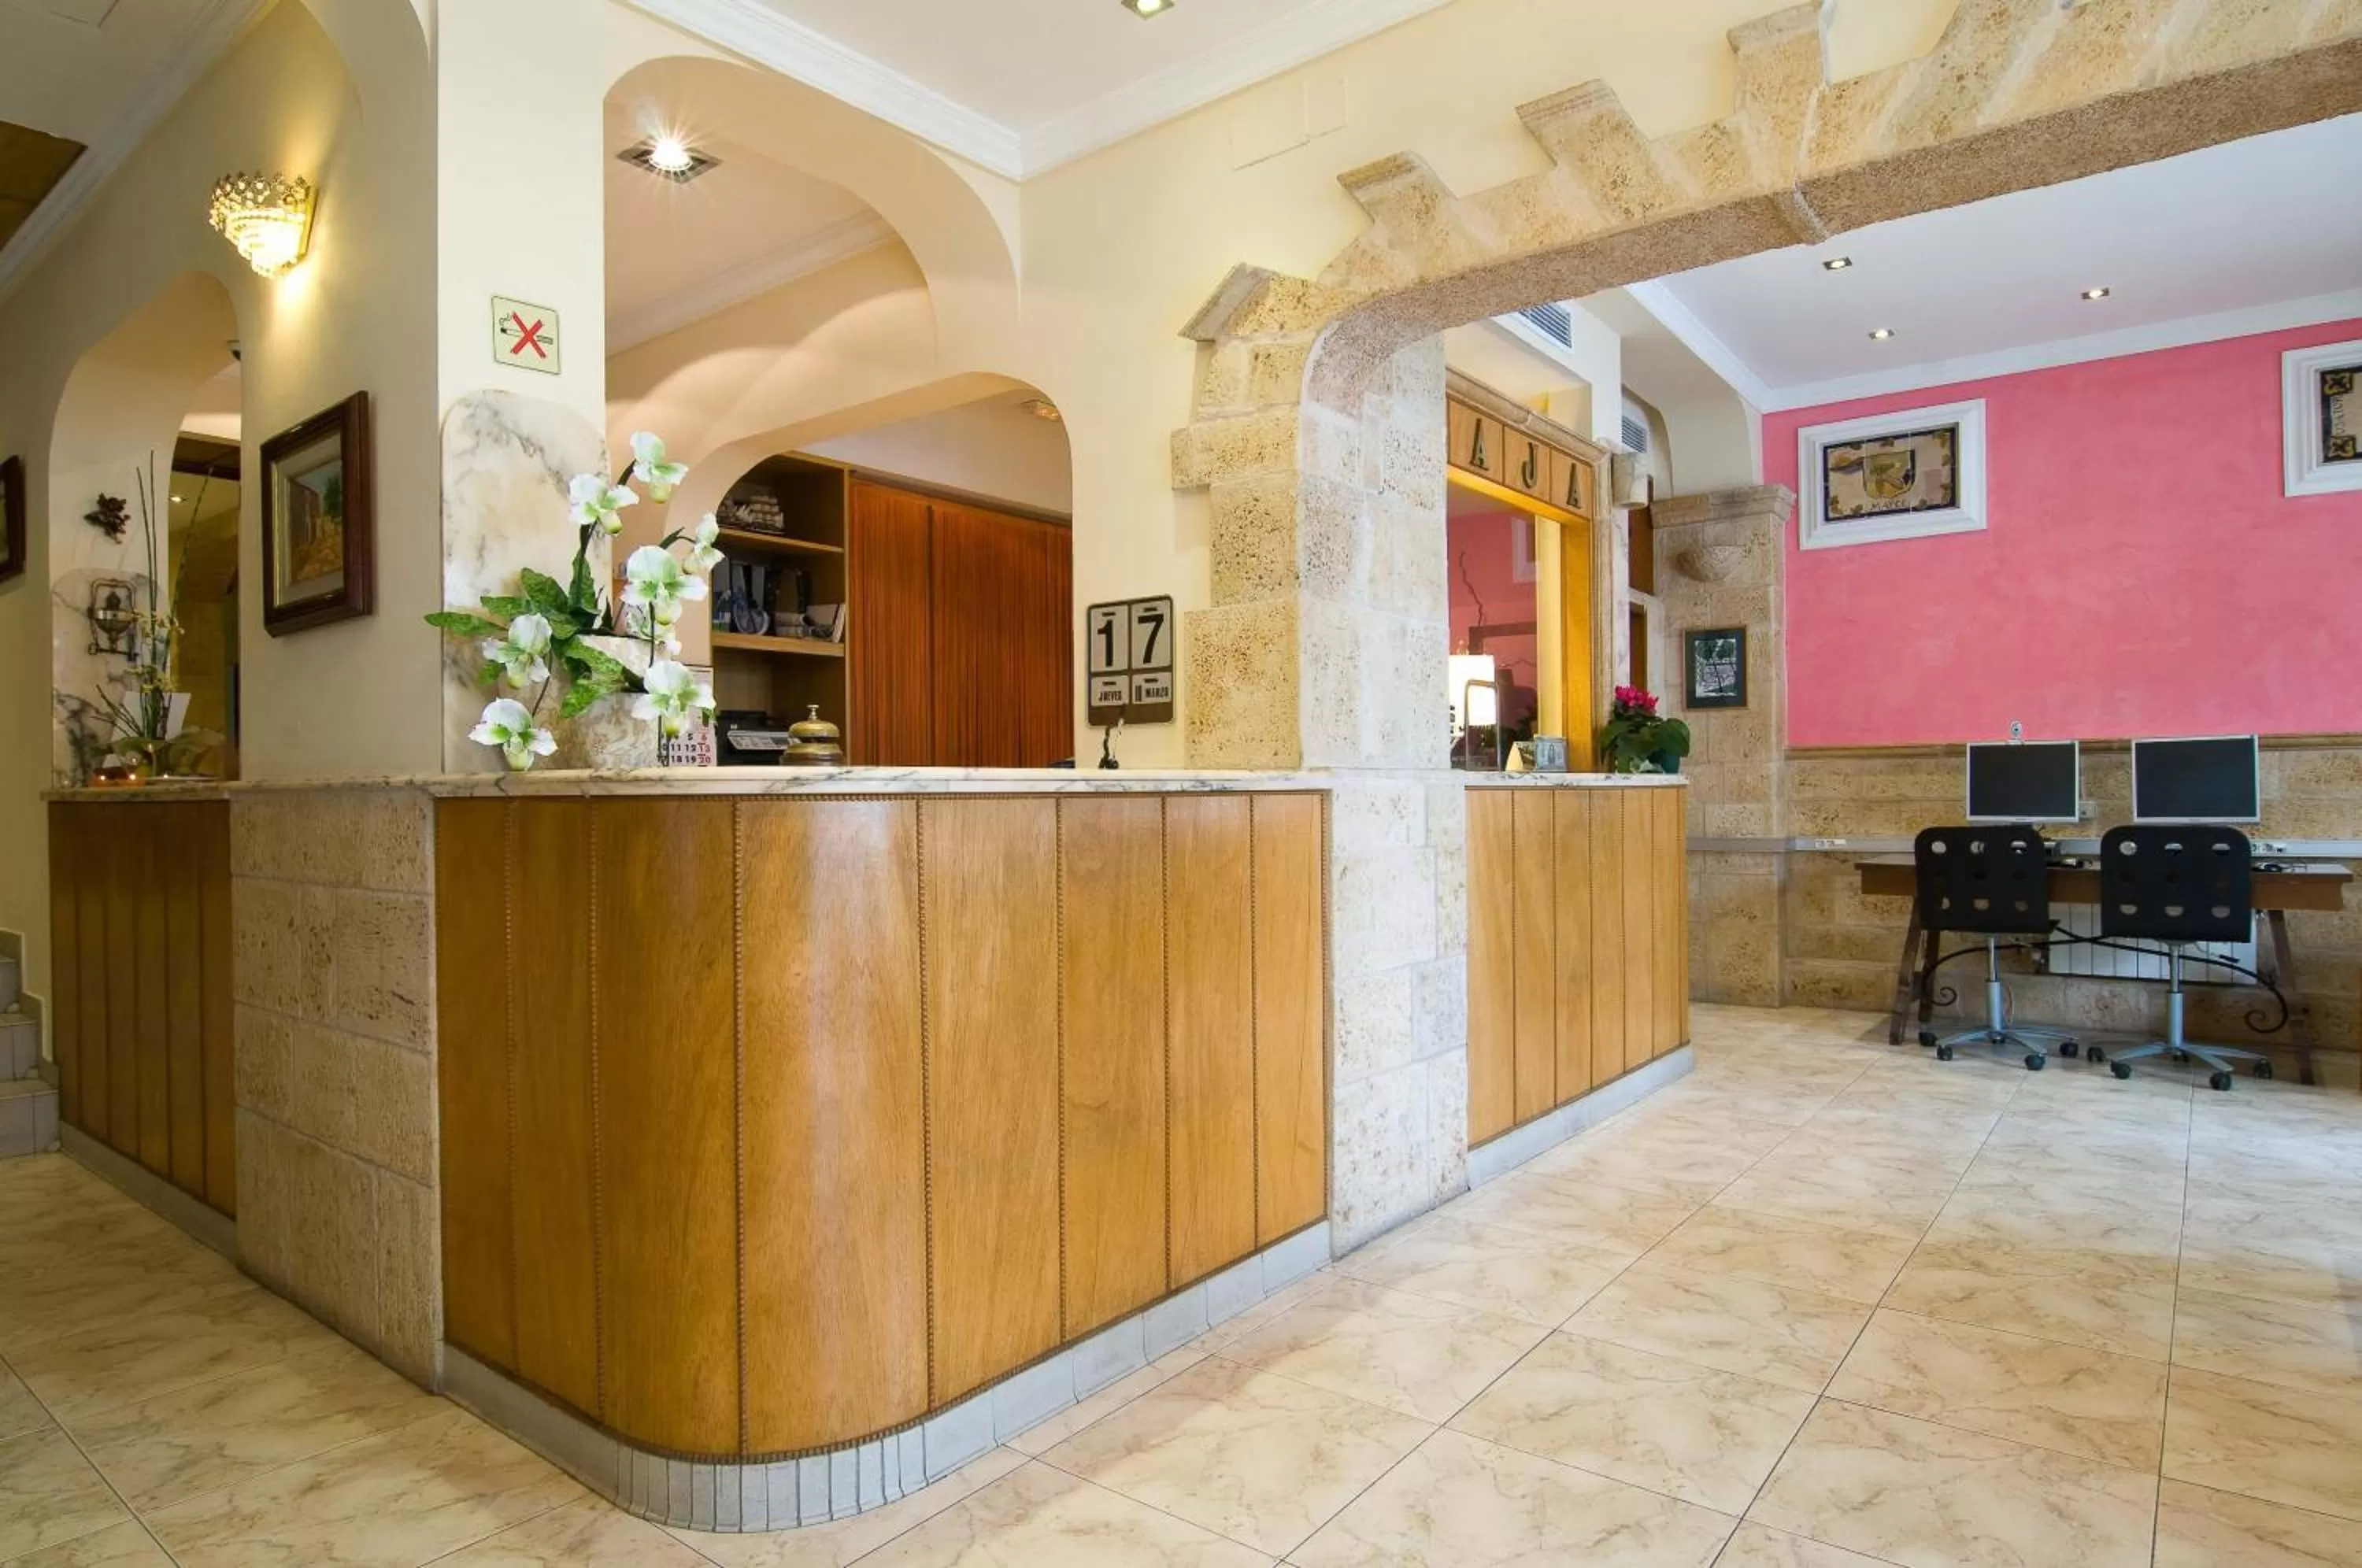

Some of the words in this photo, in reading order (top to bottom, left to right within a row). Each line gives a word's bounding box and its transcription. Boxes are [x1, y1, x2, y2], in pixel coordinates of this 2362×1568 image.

[1099, 690, 1122, 701] JUEVES
[1146, 686, 1169, 698] MARZO
[671, 743, 681, 752] 11
[698, 745, 711, 753] 13
[686, 755, 697, 764] 19
[698, 756, 711, 764] 20
